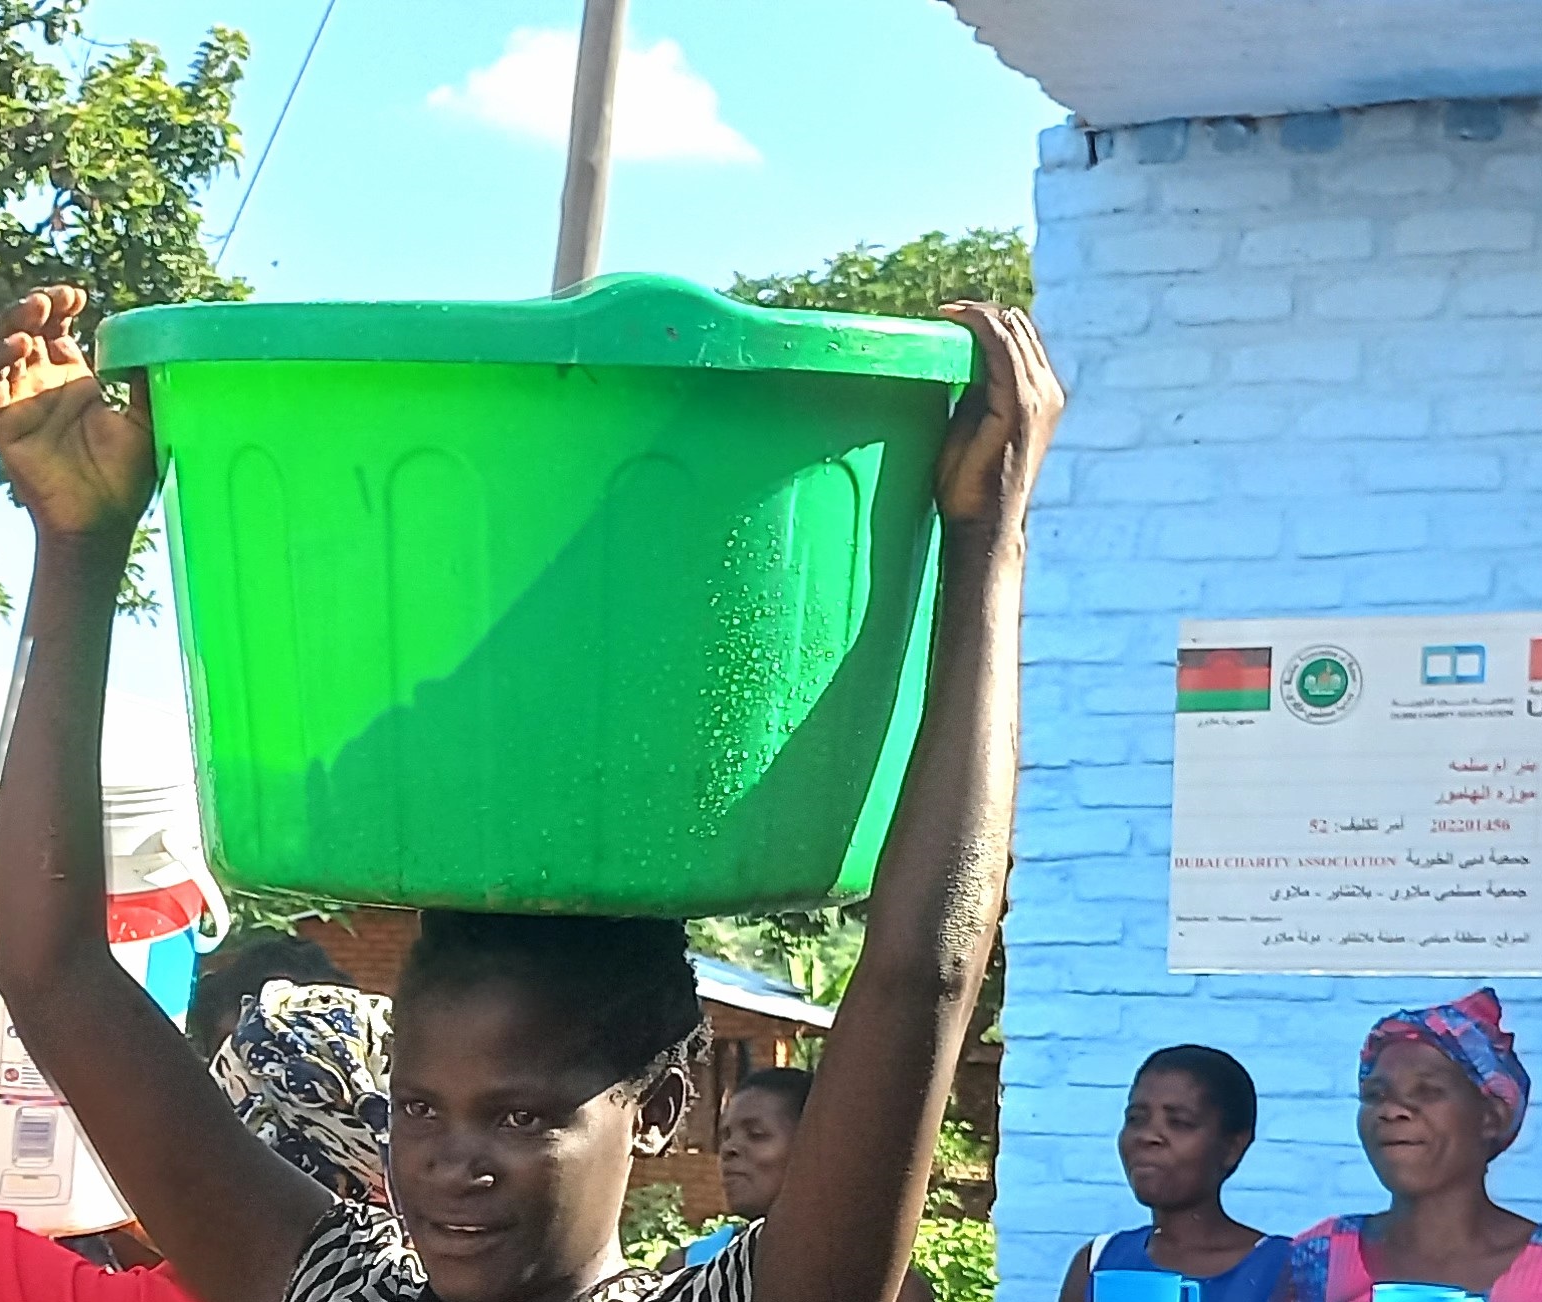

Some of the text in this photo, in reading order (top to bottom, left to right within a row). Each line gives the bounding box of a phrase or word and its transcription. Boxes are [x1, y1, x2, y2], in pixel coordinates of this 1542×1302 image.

[1174, 856, 1397, 869] DUBAI CHARITY ASSOCIATION
